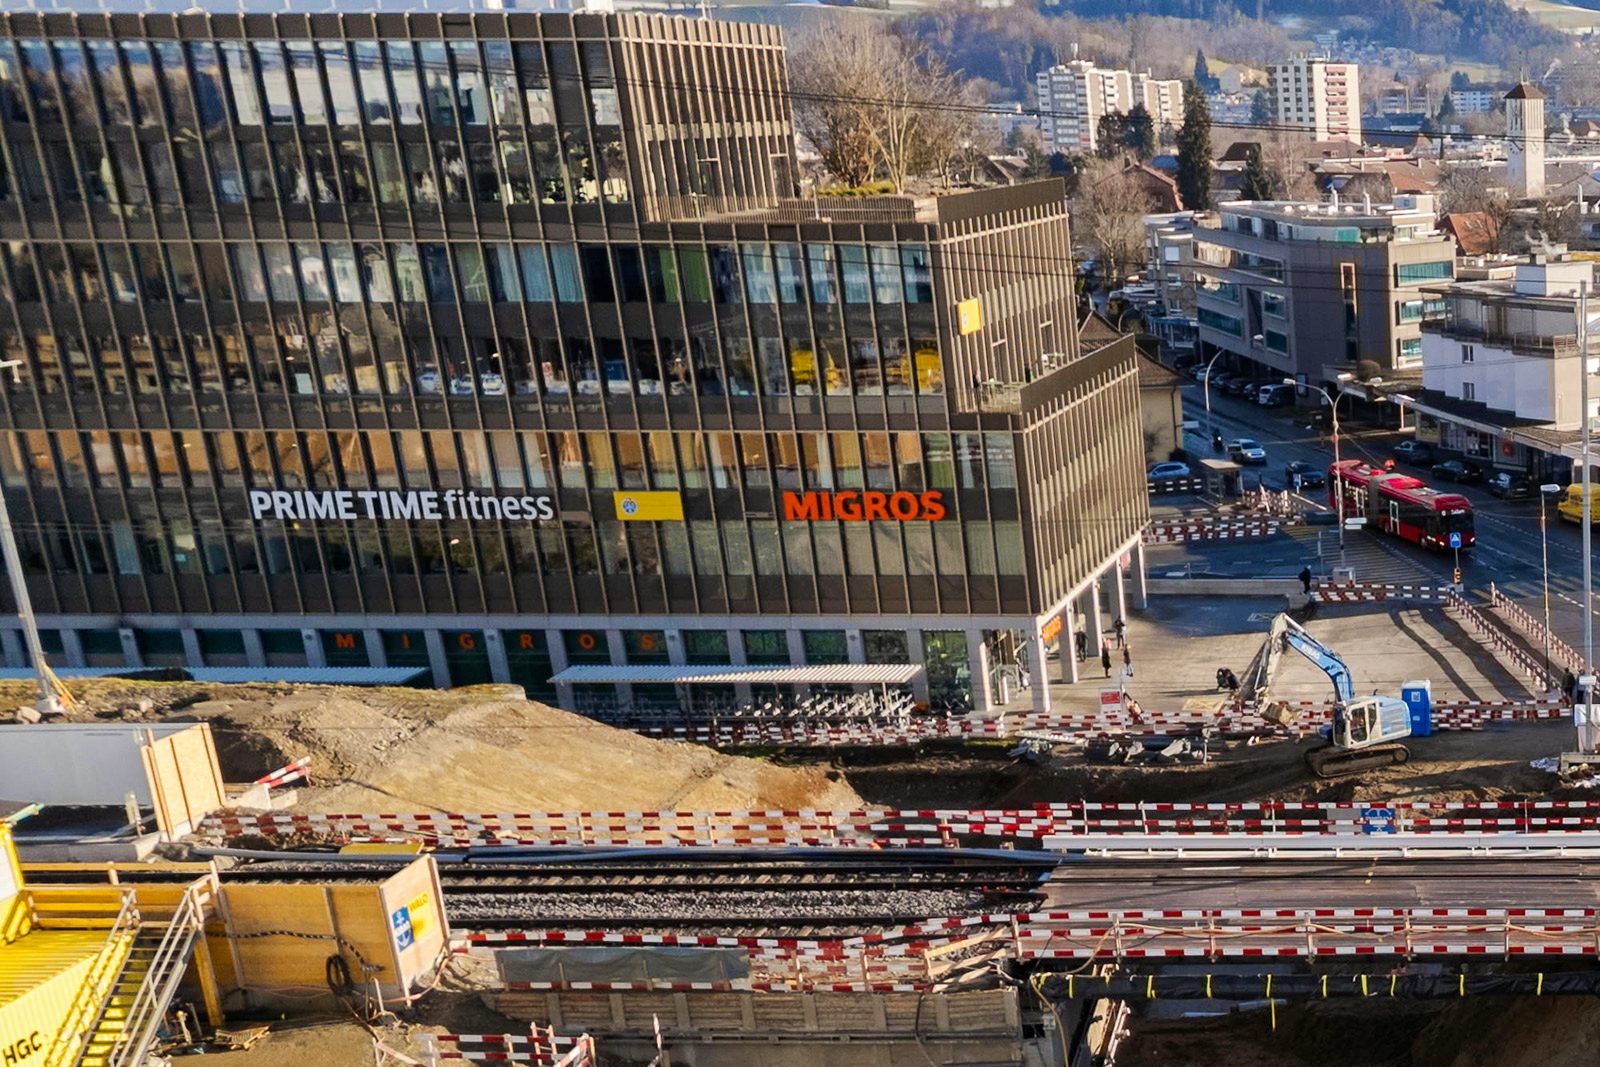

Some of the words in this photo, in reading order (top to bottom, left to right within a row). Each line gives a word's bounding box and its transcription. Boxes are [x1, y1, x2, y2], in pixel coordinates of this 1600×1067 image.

[250, 490, 357, 520] PRIME
[357, 490, 442, 520] TIME
[443, 489, 554, 520] fitness
[782, 490, 946, 521] MIGROS
[3, 1030, 42, 1067] HGC
